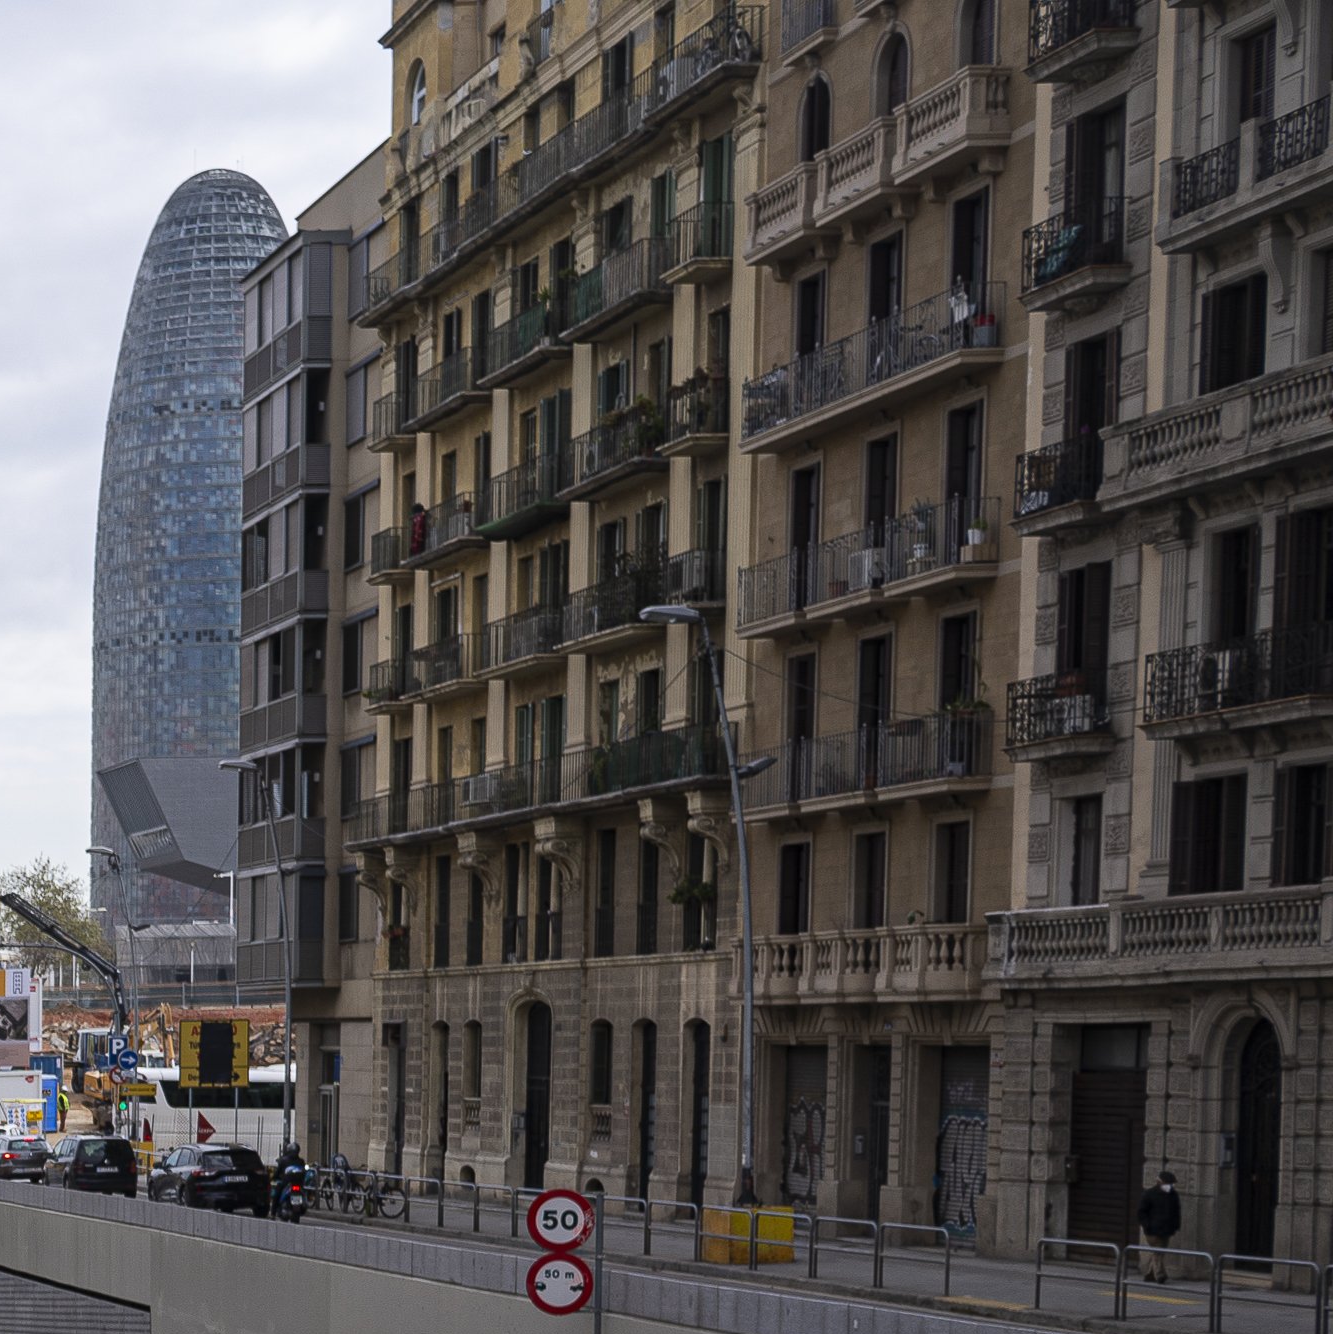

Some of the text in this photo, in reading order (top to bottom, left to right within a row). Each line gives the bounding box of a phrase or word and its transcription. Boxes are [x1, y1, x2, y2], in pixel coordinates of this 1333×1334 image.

[542, 1209, 579, 1231] 50
[544, 1269, 575, 1279] 50 m
